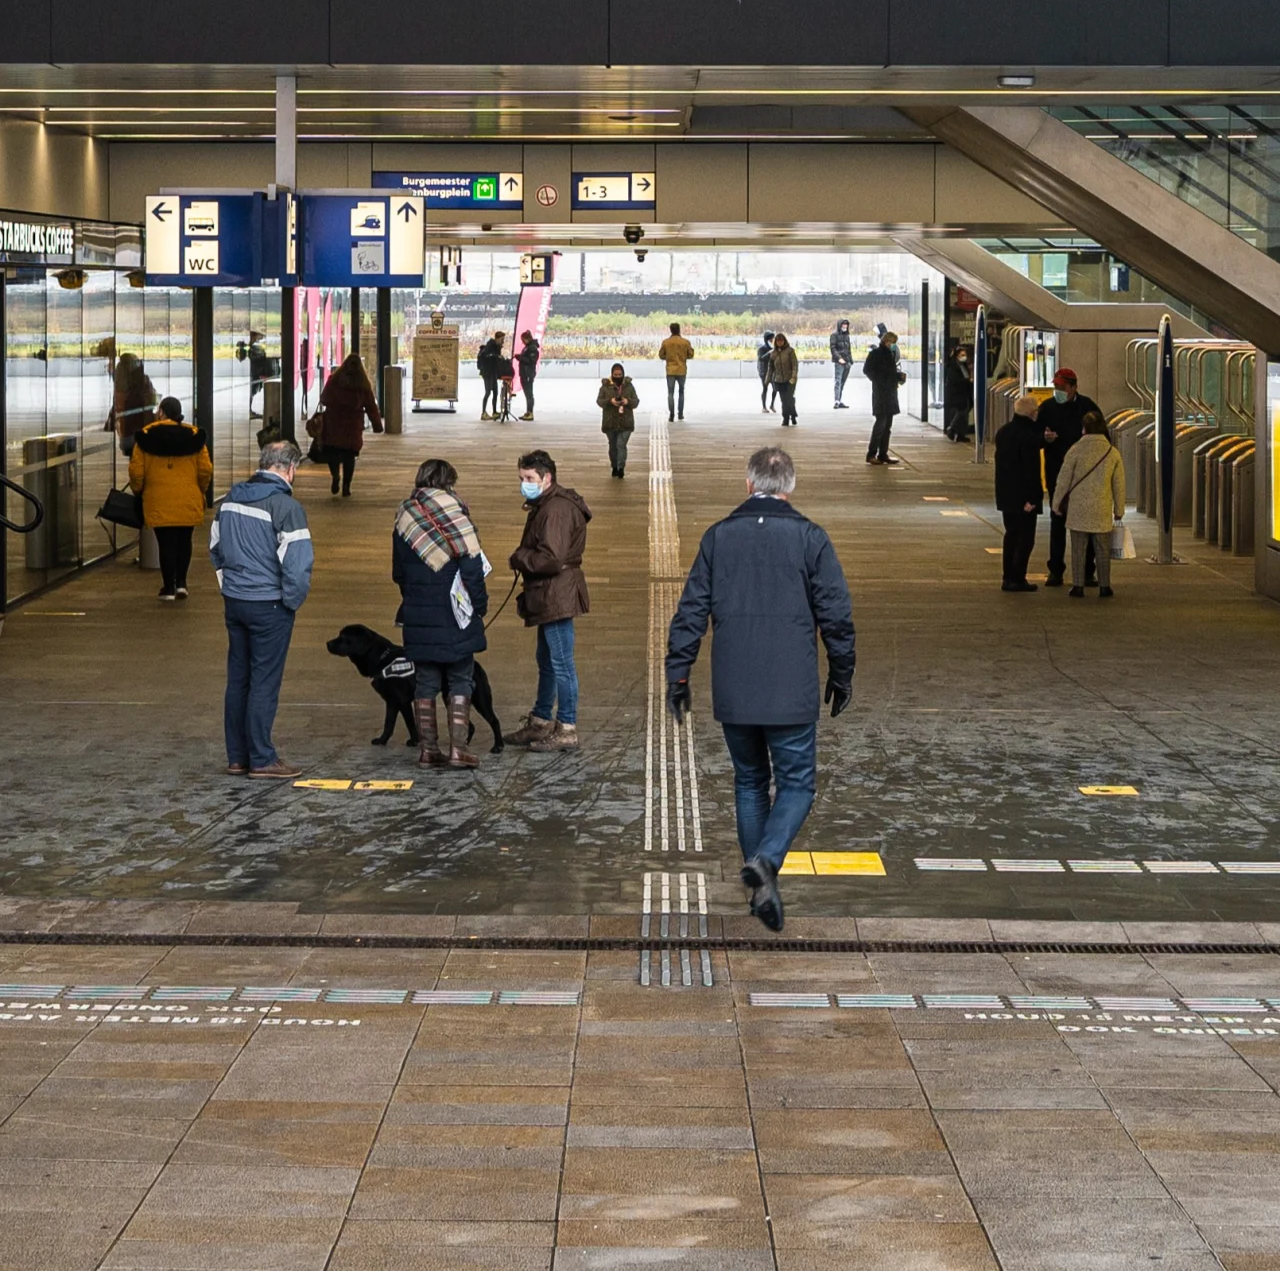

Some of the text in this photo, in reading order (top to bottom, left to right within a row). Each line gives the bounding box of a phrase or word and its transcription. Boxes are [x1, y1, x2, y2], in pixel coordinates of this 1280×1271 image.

[402, 176, 470, 187] Burgemeester
[412, 188, 470, 198] enburgplein
[46, 226, 74, 254] COFFEE
[188, 258, 214, 270] WC
[75, 1015, 199, 1024] METER
[1122, 1014, 1250, 1023] METER
